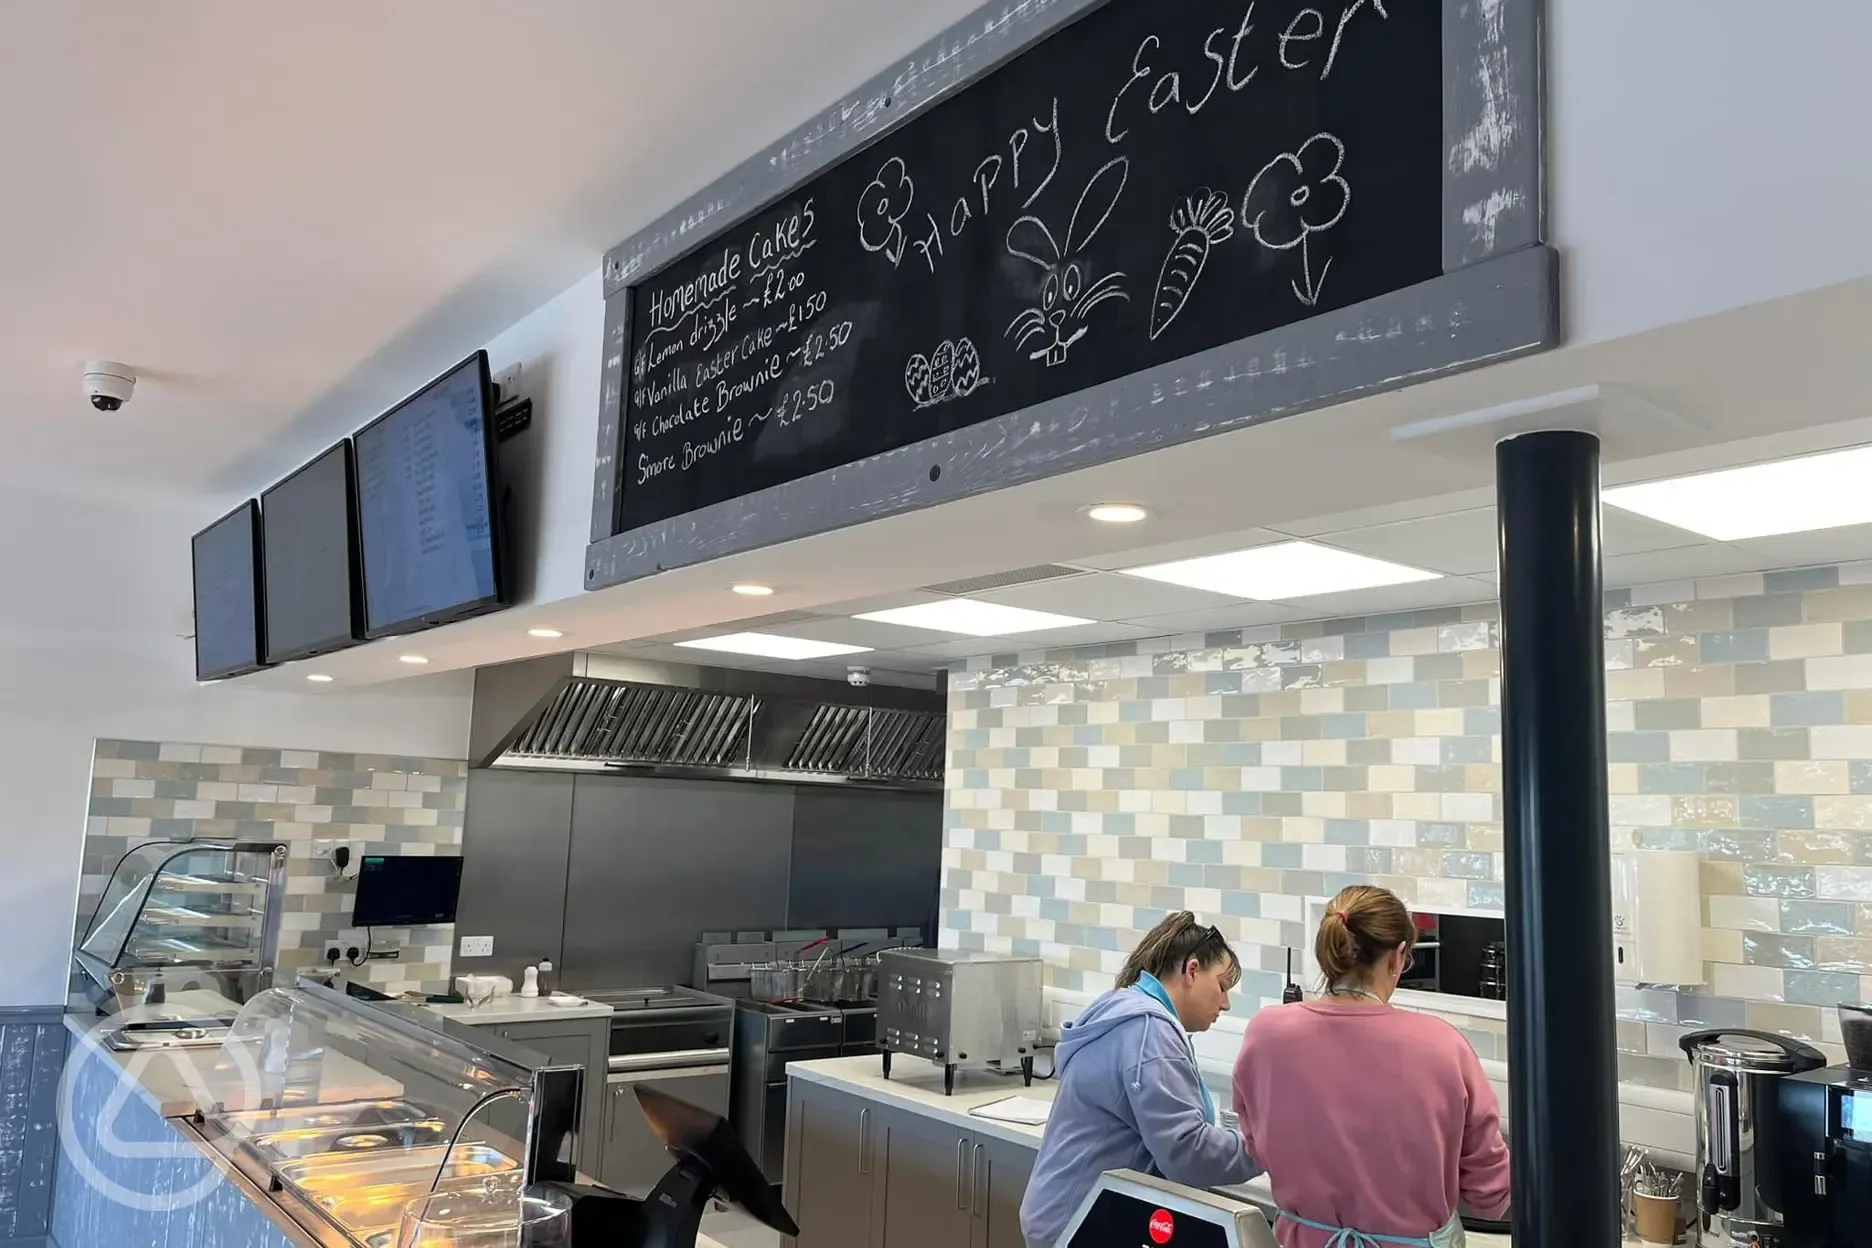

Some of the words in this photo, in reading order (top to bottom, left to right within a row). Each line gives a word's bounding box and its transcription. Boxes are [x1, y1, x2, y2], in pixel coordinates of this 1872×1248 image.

[648, 248, 742, 328] Homemade
[647, 341, 684, 373] Lemon
[689, 297, 738, 352] drizzle
[647, 367, 688, 408] Vanilla
[696, 344, 739, 389] Easter
[652, 396, 711, 437] Chocolate
[715, 353, 784, 414] Brownie
[637, 452, 676, 485] Smore
[681, 415, 744, 471] Brownie
[776, 379, 835, 428] £2.50
